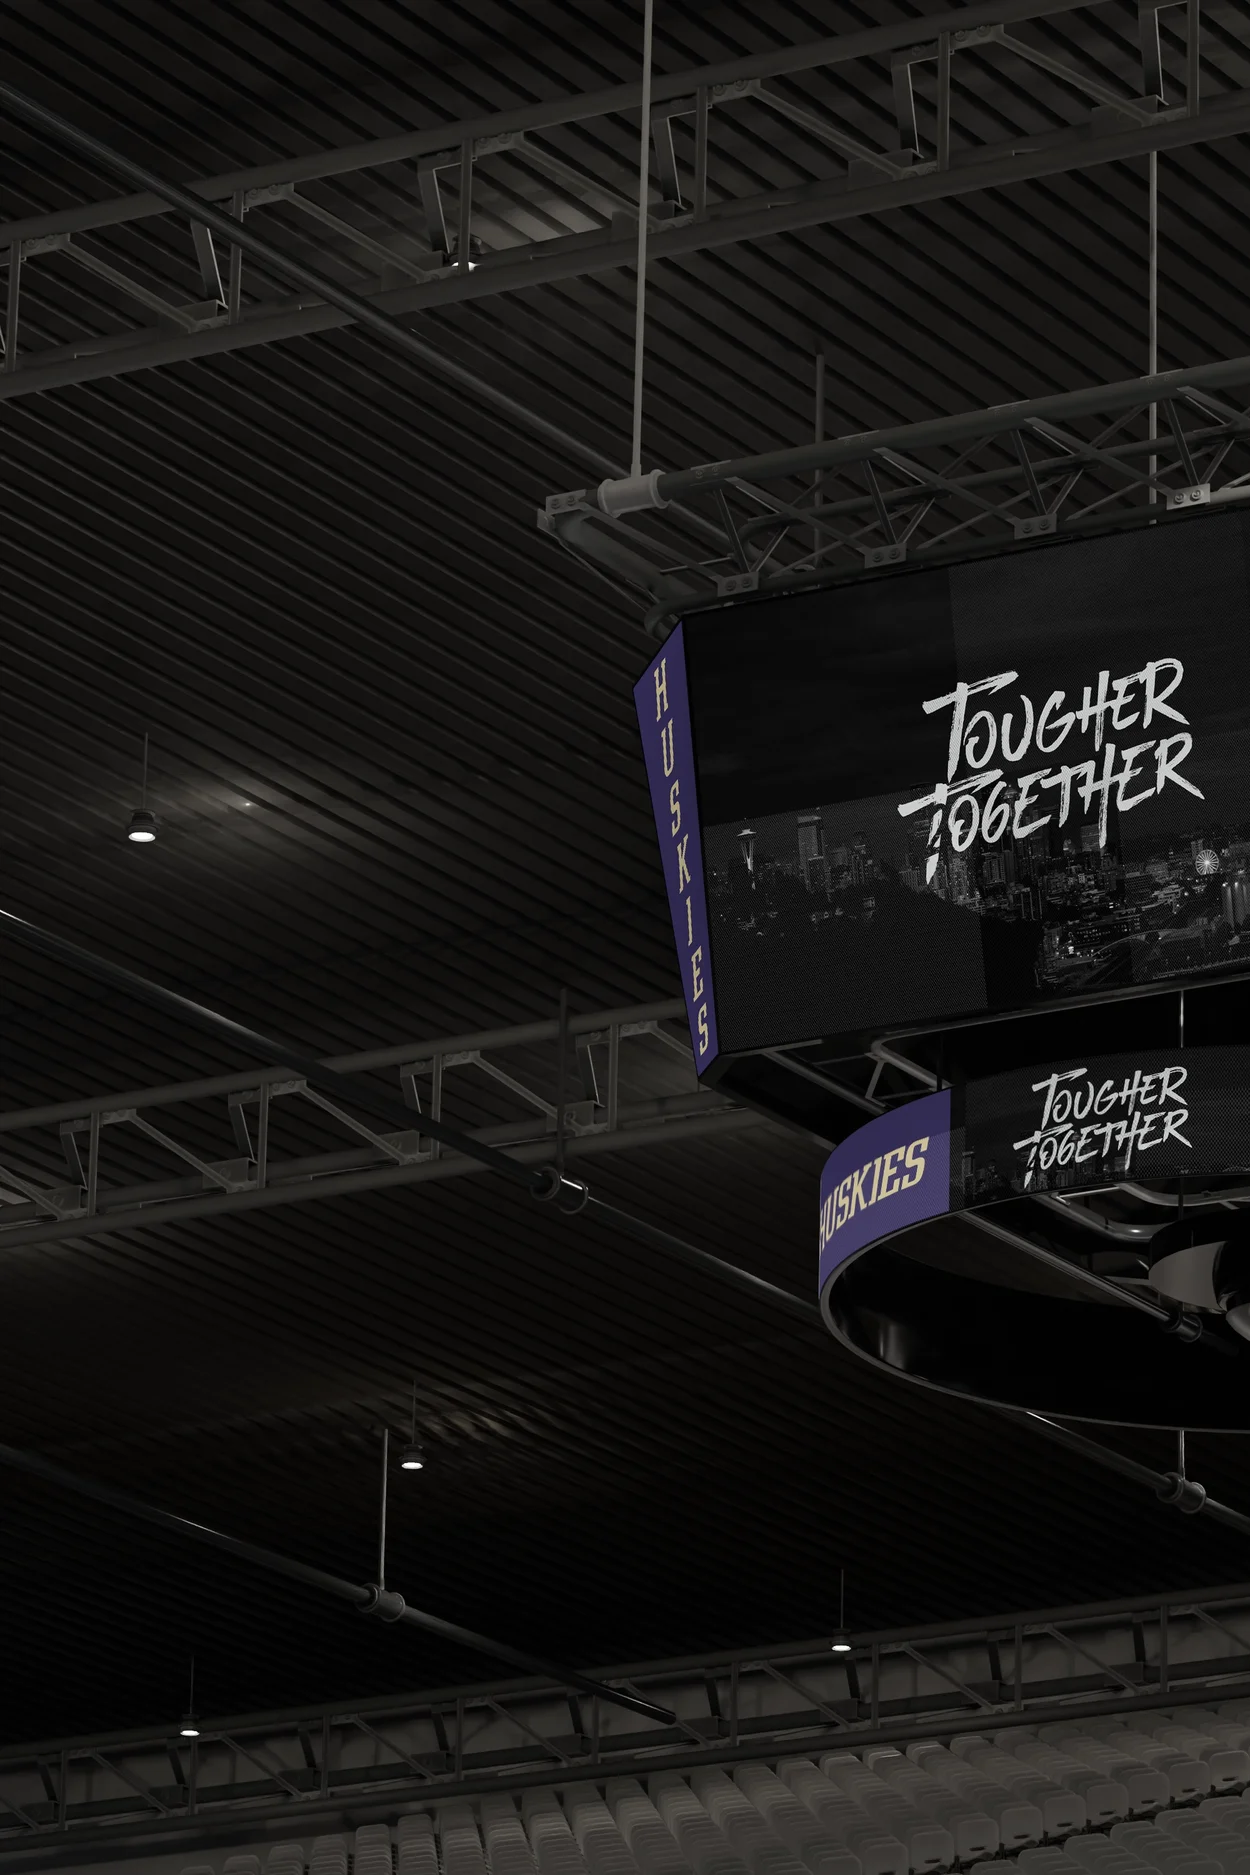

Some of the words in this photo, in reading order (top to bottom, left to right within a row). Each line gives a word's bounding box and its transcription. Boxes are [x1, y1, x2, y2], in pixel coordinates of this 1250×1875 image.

[922, 657, 1191, 782] TOUGHER
[653, 657, 710, 1056] HUSKIES
[897, 732, 1205, 885] TOGETHER
[1012, 1109, 1193, 1189] TOGETHER
[1032, 1066, 1189, 1130] TOUGHER
